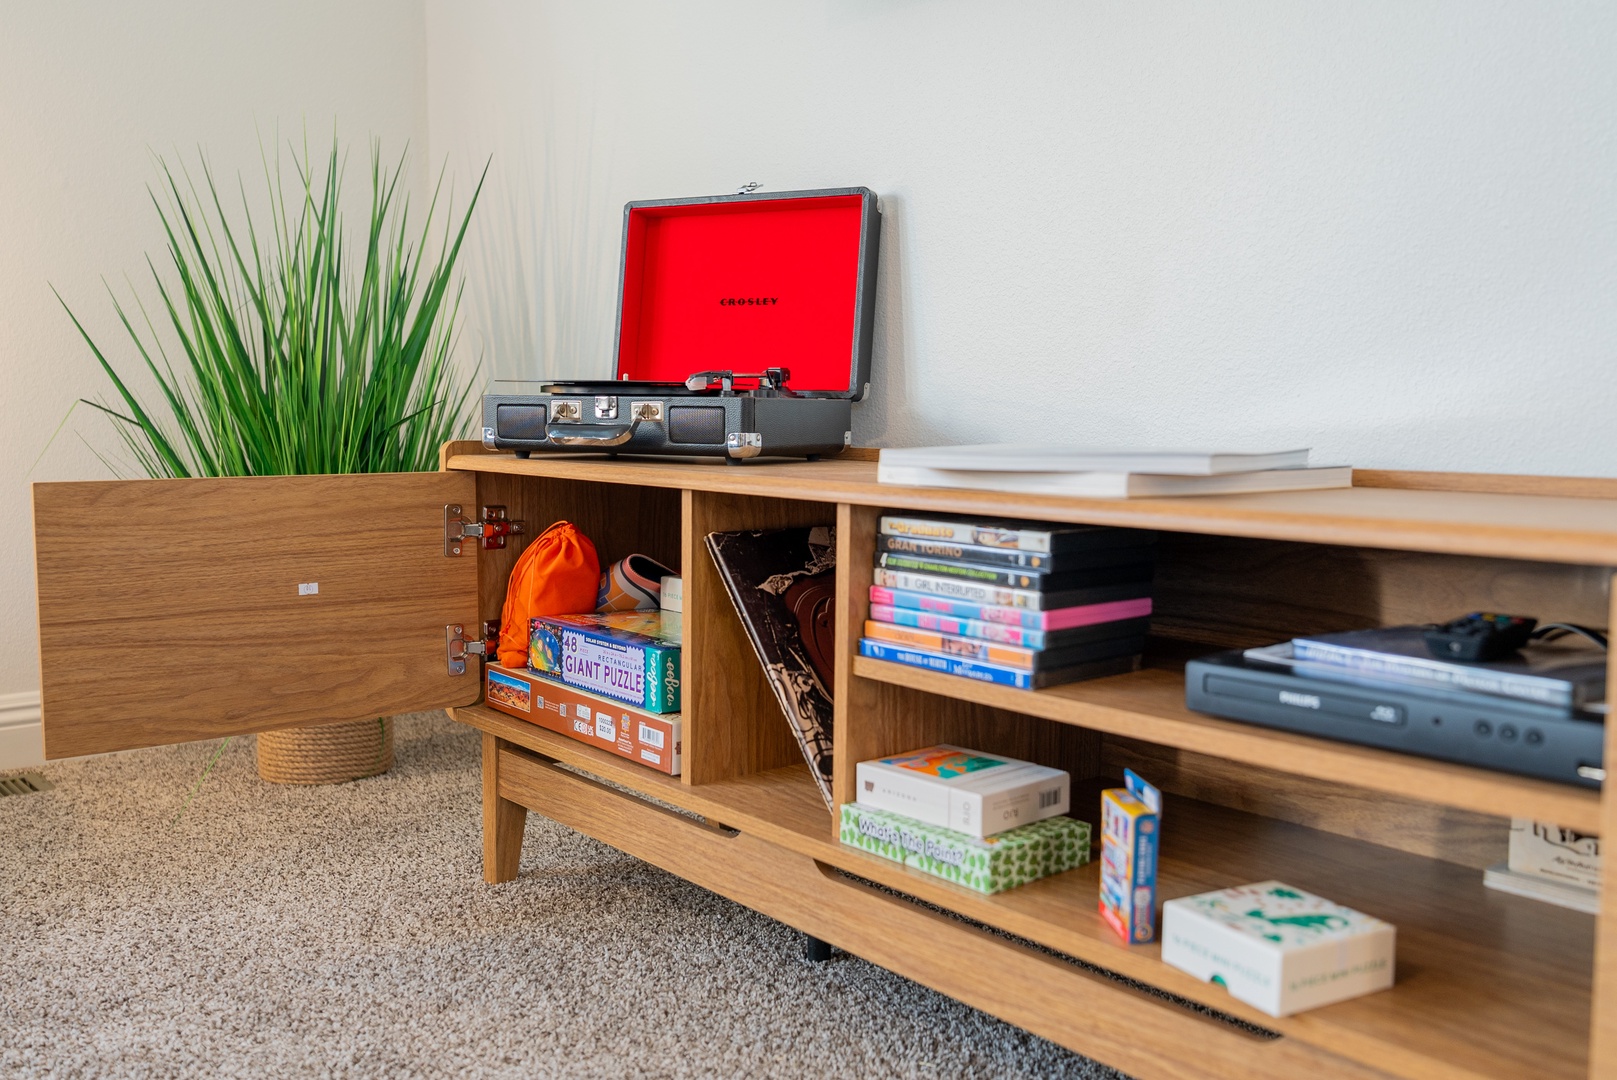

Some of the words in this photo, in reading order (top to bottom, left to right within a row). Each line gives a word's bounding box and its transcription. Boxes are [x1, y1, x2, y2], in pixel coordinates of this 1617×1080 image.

[720, 297, 778, 306] CROSLEY
[897, 522, 954, 538] Graduate
[887, 538, 917, 553] GRAN
[920, 543, 963, 557] TORINO
[935, 580, 986, 599] INTERRUPTED
[564, 635, 577, 653] 48
[612, 644, 626, 652] BEYOND
[598, 655, 642, 671] RECTANGULAR
[565, 655, 600, 680] GIANT
[604, 665, 642, 693] PUZZLE
[1279, 690, 1321, 710] PHILIPS
[858, 815, 899, 845] What's
[901, 831, 923, 852] The
[925, 837, 964, 867] Point?
